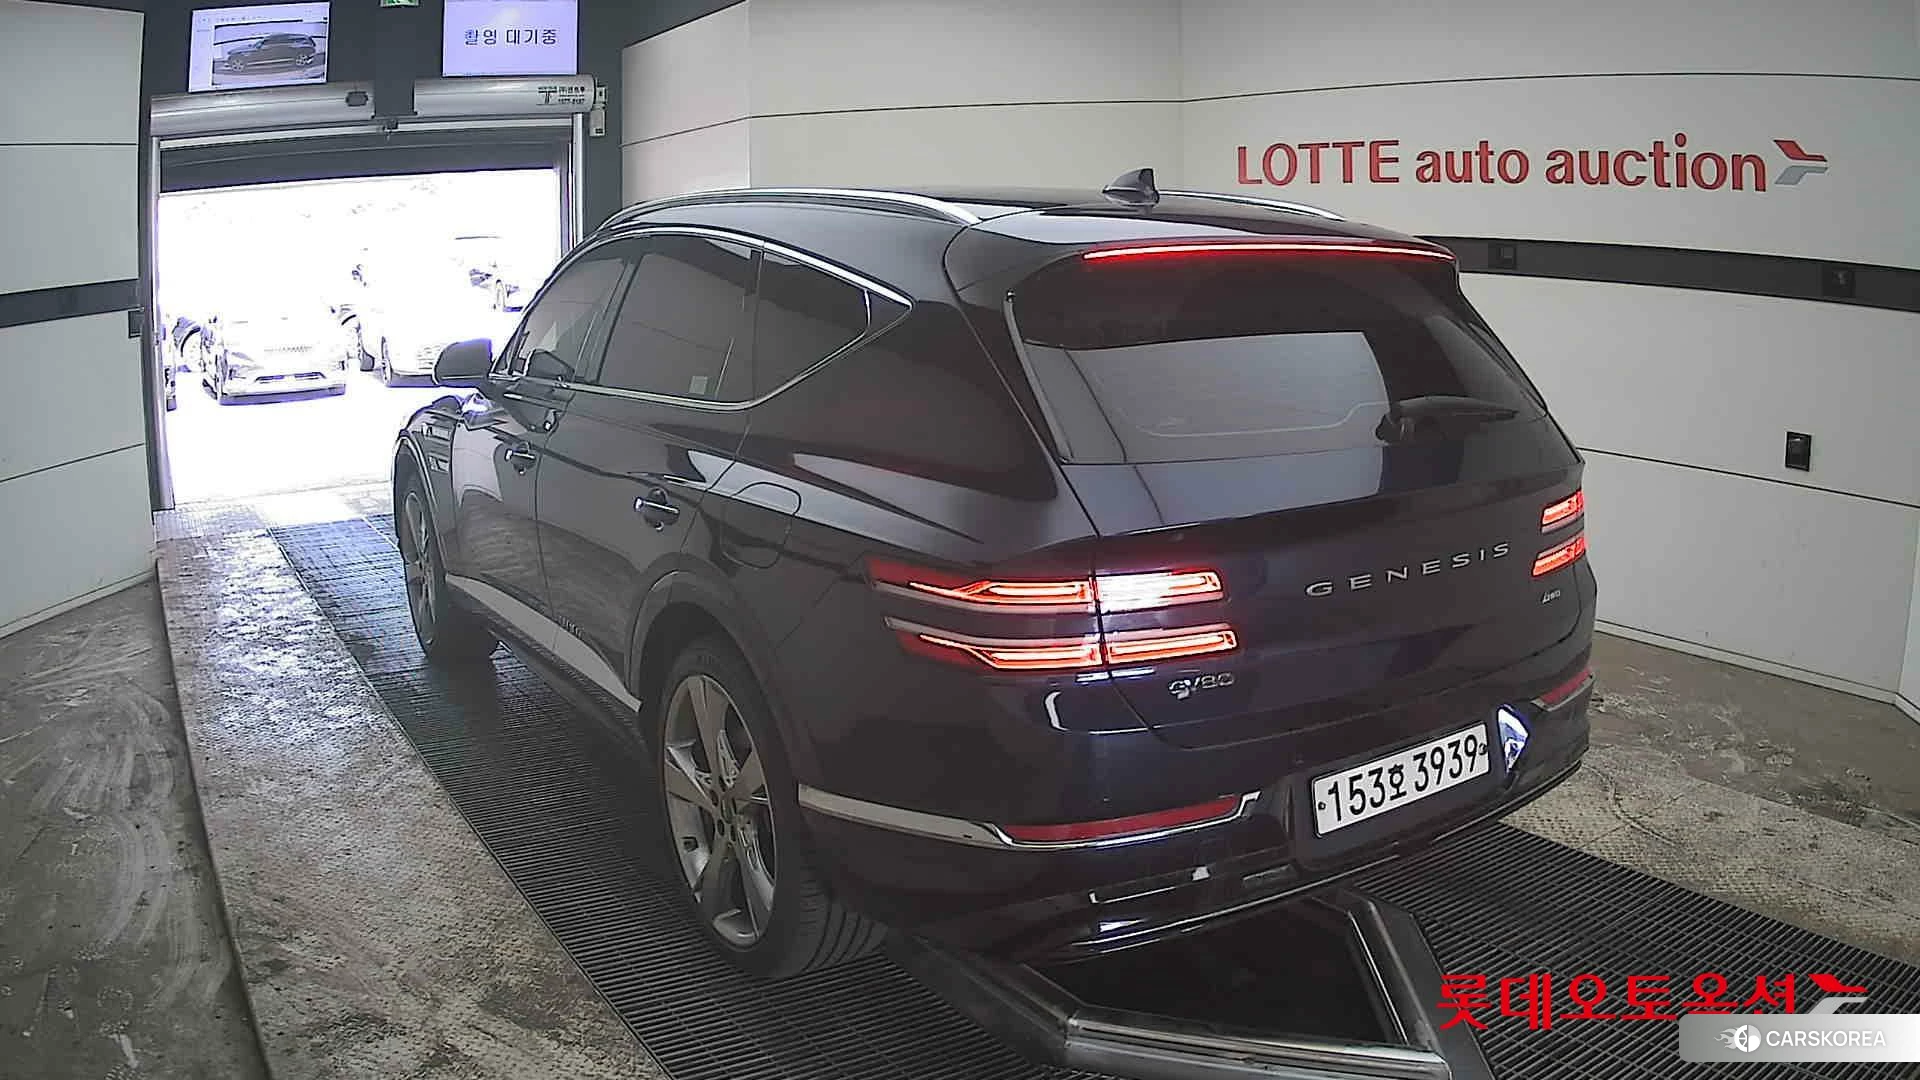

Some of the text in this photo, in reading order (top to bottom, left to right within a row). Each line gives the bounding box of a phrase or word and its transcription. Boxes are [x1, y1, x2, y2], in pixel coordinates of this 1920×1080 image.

[506, 29, 556, 45] 대기중
[1237, 132, 1767, 192] LOTTE auto auction
[1305, 543, 1510, 597] GENESIS
[1169, 673, 1234, 700] GV80
[1327, 734, 1478, 822] 153호 3939
